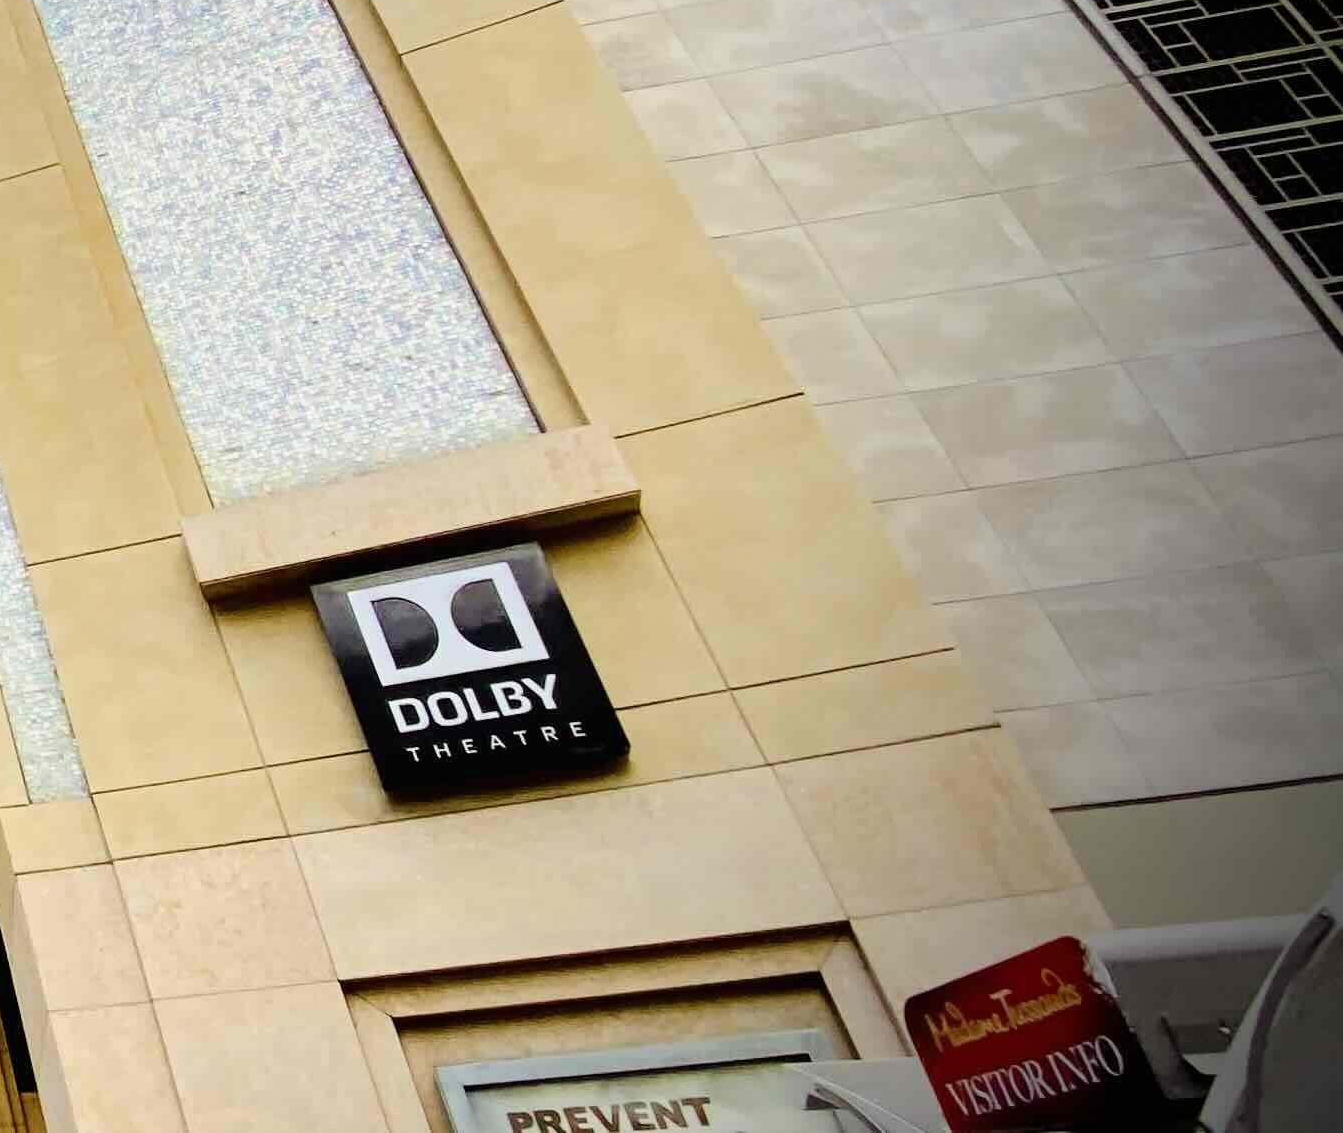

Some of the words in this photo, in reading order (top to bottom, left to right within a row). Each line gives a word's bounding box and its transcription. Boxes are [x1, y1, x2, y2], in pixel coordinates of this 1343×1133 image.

[387, 673, 558, 735] DOLBY
[405, 720, 588, 763] THEATRE
[945, 1059, 1057, 1116] VISITOR
[1045, 1034, 1125, 1093] INFO
[507, 1097, 711, 1133] PREVENT
